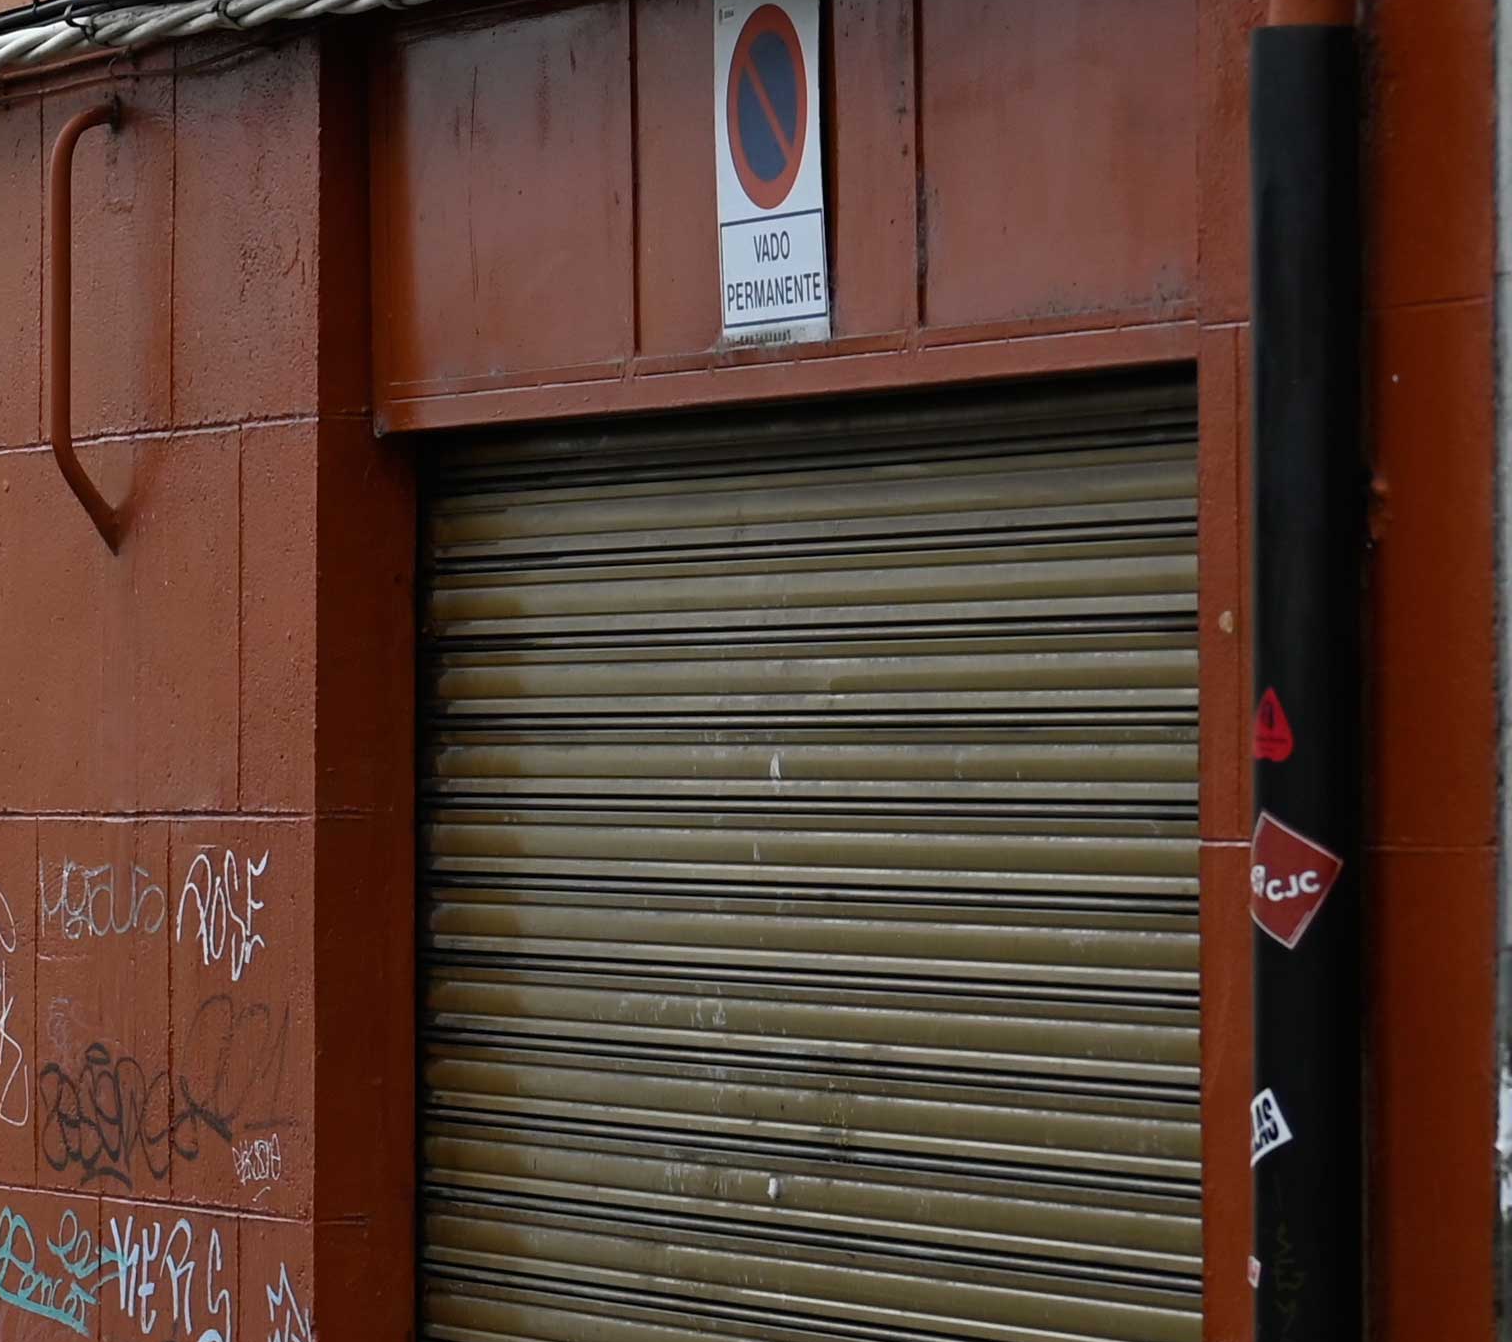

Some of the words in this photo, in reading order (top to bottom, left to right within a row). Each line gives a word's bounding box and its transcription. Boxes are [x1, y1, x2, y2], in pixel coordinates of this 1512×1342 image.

[753, 230, 790, 263] VADO
[727, 271, 822, 312] PERMANENTE
[1266, 870, 1321, 902] CJC
